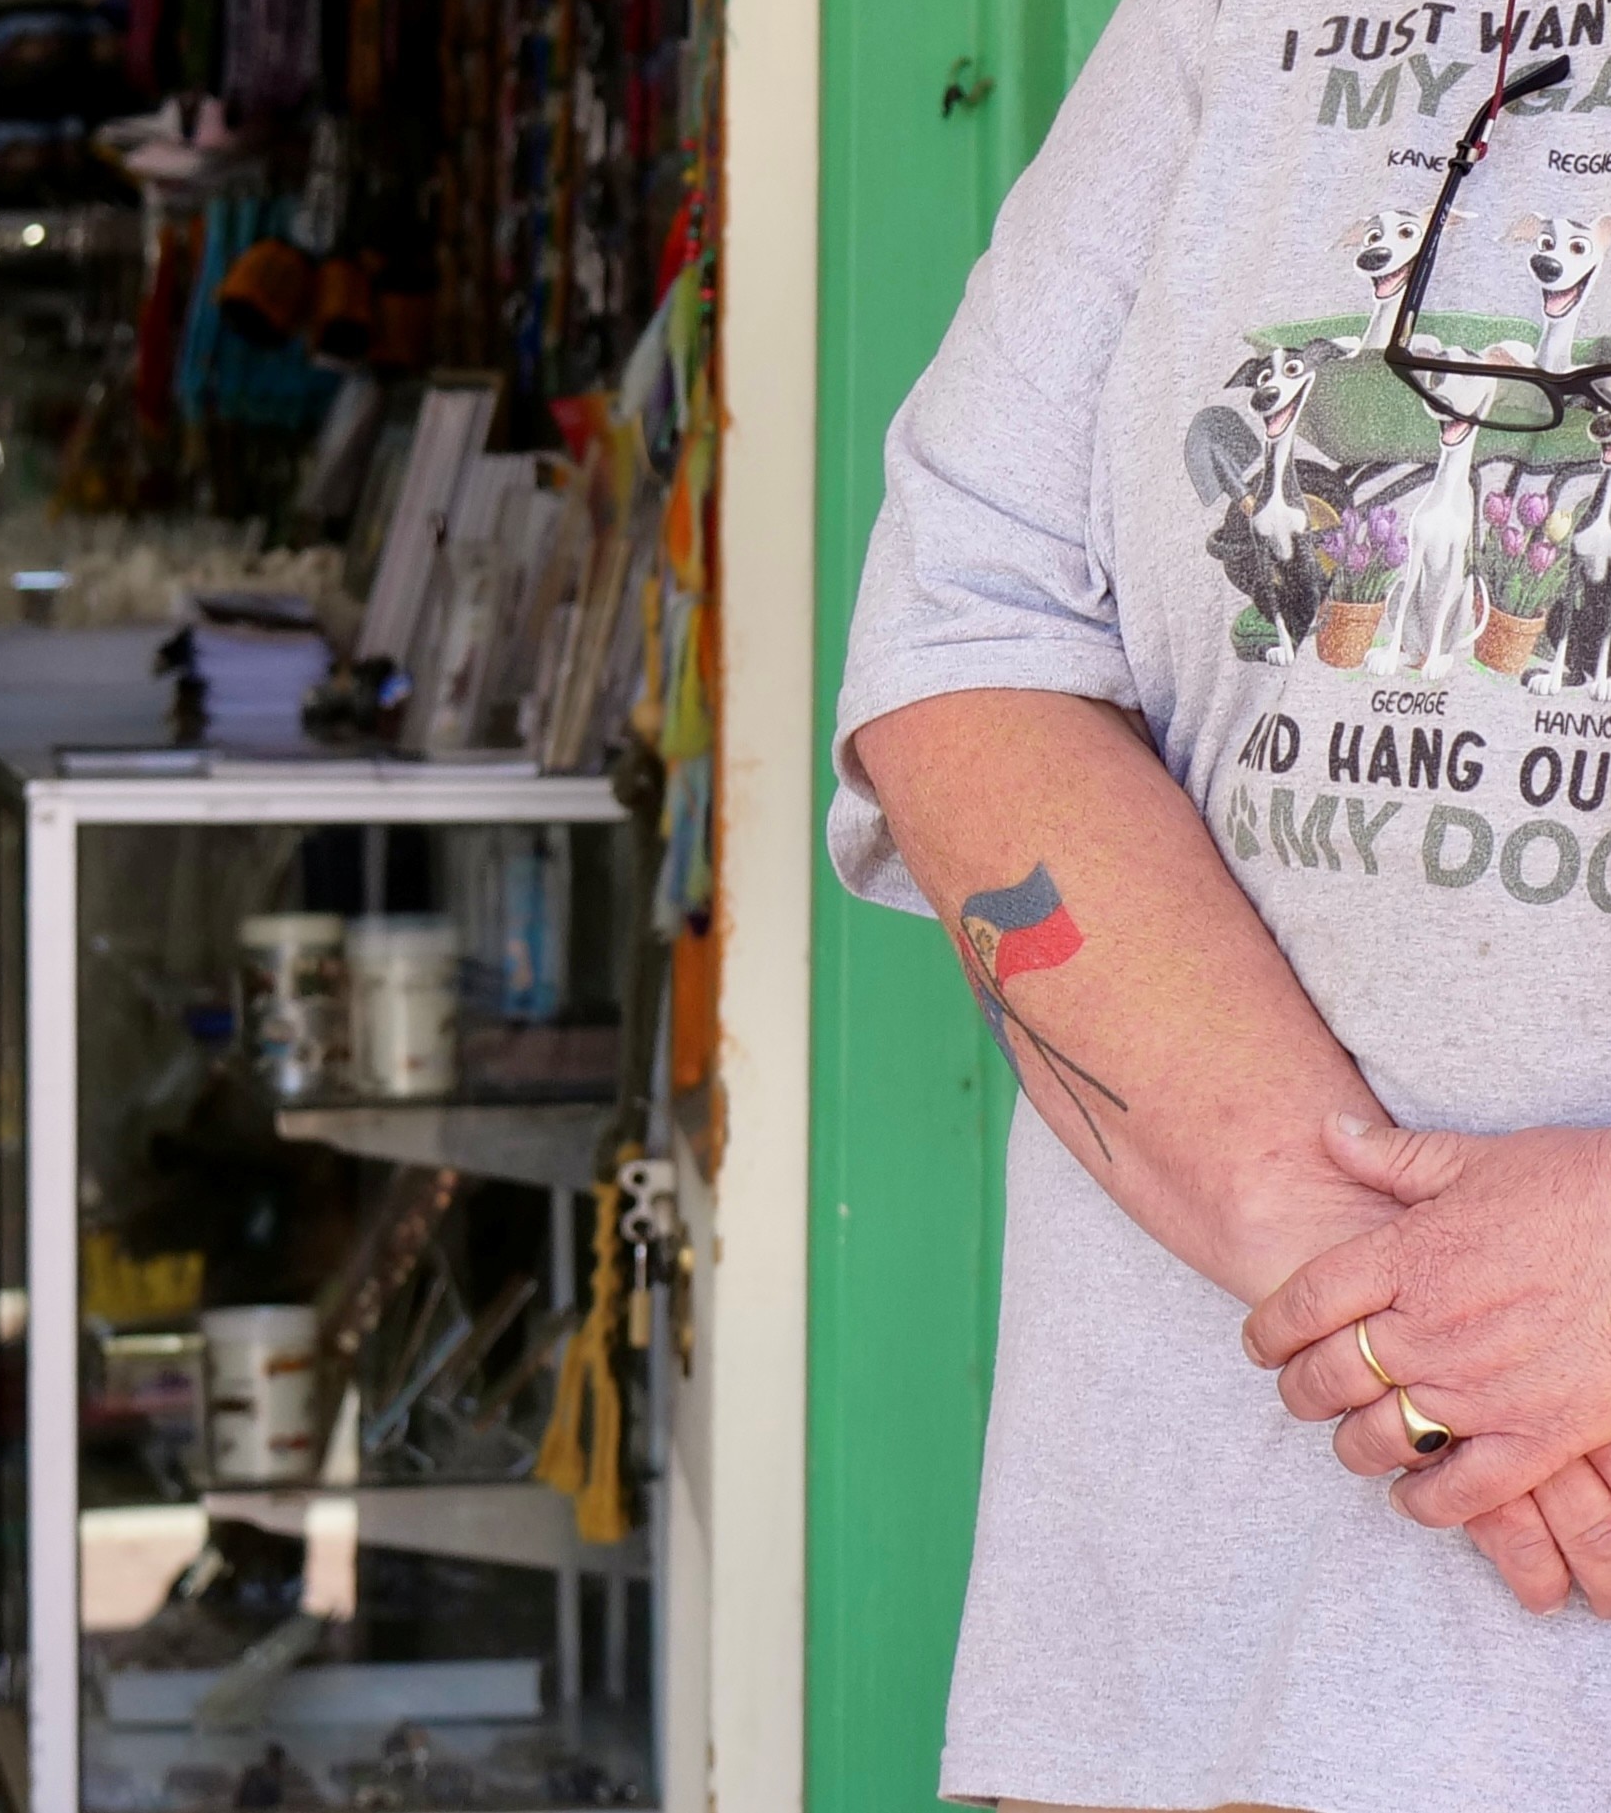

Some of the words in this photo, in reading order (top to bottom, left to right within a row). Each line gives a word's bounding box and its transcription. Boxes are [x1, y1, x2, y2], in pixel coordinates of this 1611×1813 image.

[1282, 29, 1299, 72] I
[1314, 1, 1457, 62] JUST
[1316, 52, 1476, 130] MY
[1387, 148, 1447, 173] KANE
[1371, 689, 1449, 716] GEORGE
[1328, 721, 1487, 793] HANG
[1268, 787, 1404, 876] MY
